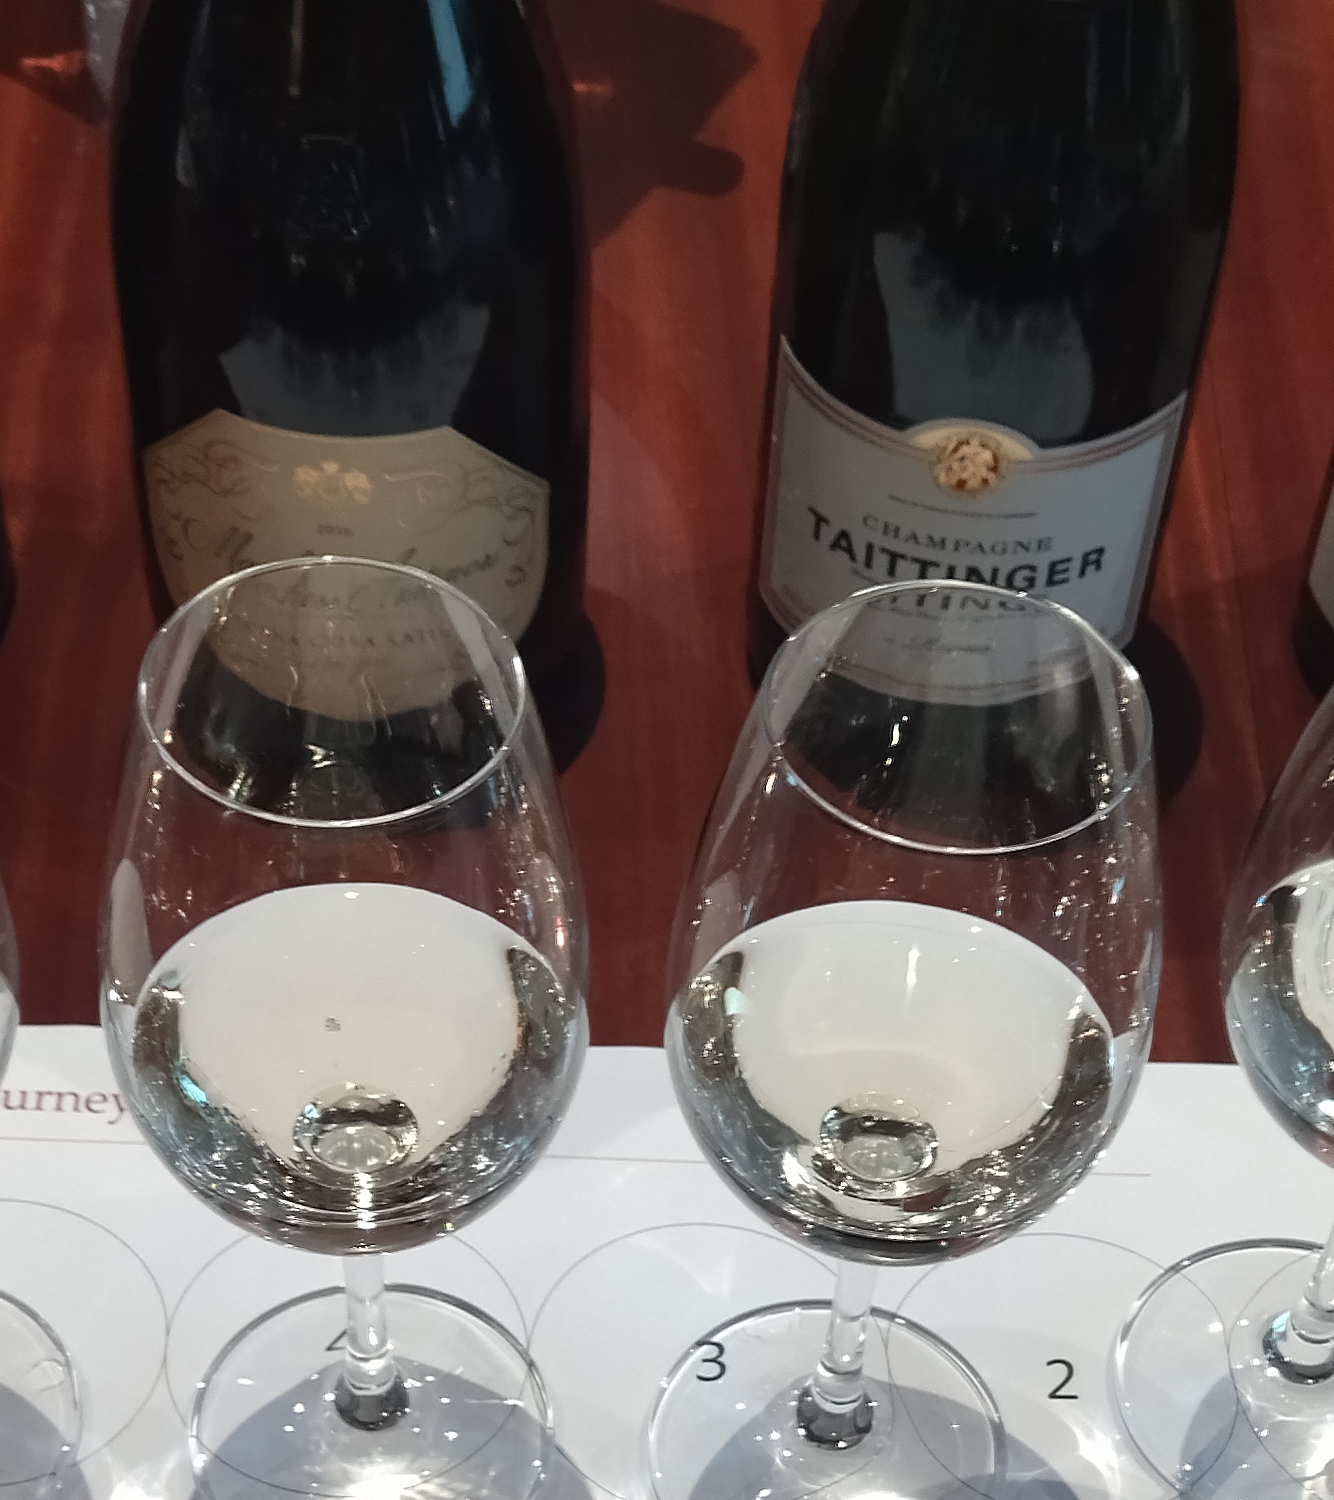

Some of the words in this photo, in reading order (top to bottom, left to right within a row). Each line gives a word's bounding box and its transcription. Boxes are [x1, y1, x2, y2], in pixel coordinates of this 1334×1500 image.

[807, 505, 1106, 594] TAITTINGER
[861, 512, 1054, 556] CHAMPAGNE
[696, 1340, 727, 1382] 3
[1046, 1358, 1079, 1400] 2
